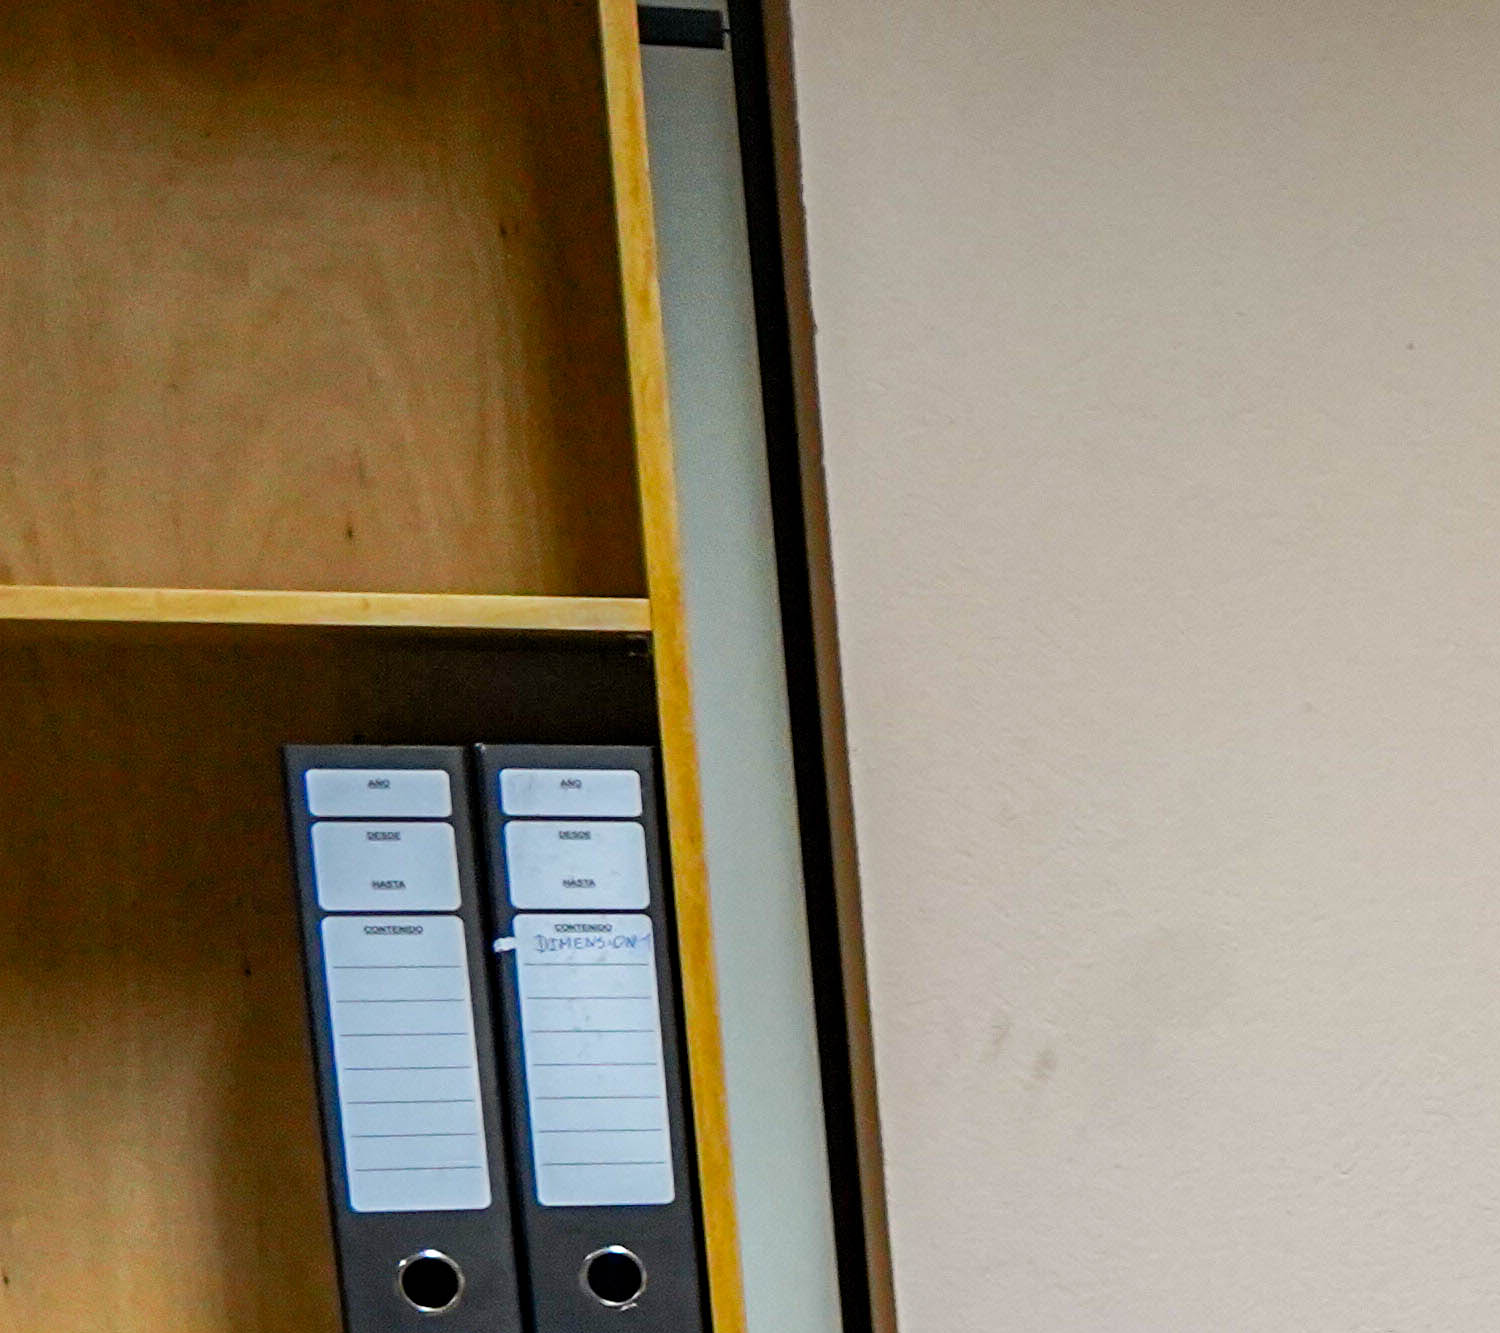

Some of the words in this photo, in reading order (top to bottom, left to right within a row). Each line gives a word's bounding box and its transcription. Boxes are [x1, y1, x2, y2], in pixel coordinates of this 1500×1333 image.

[371, 880, 407, 890] HASTA
[363, 925, 424, 936] CONTENIDO
[554, 923, 613, 933] CONTENIDO
